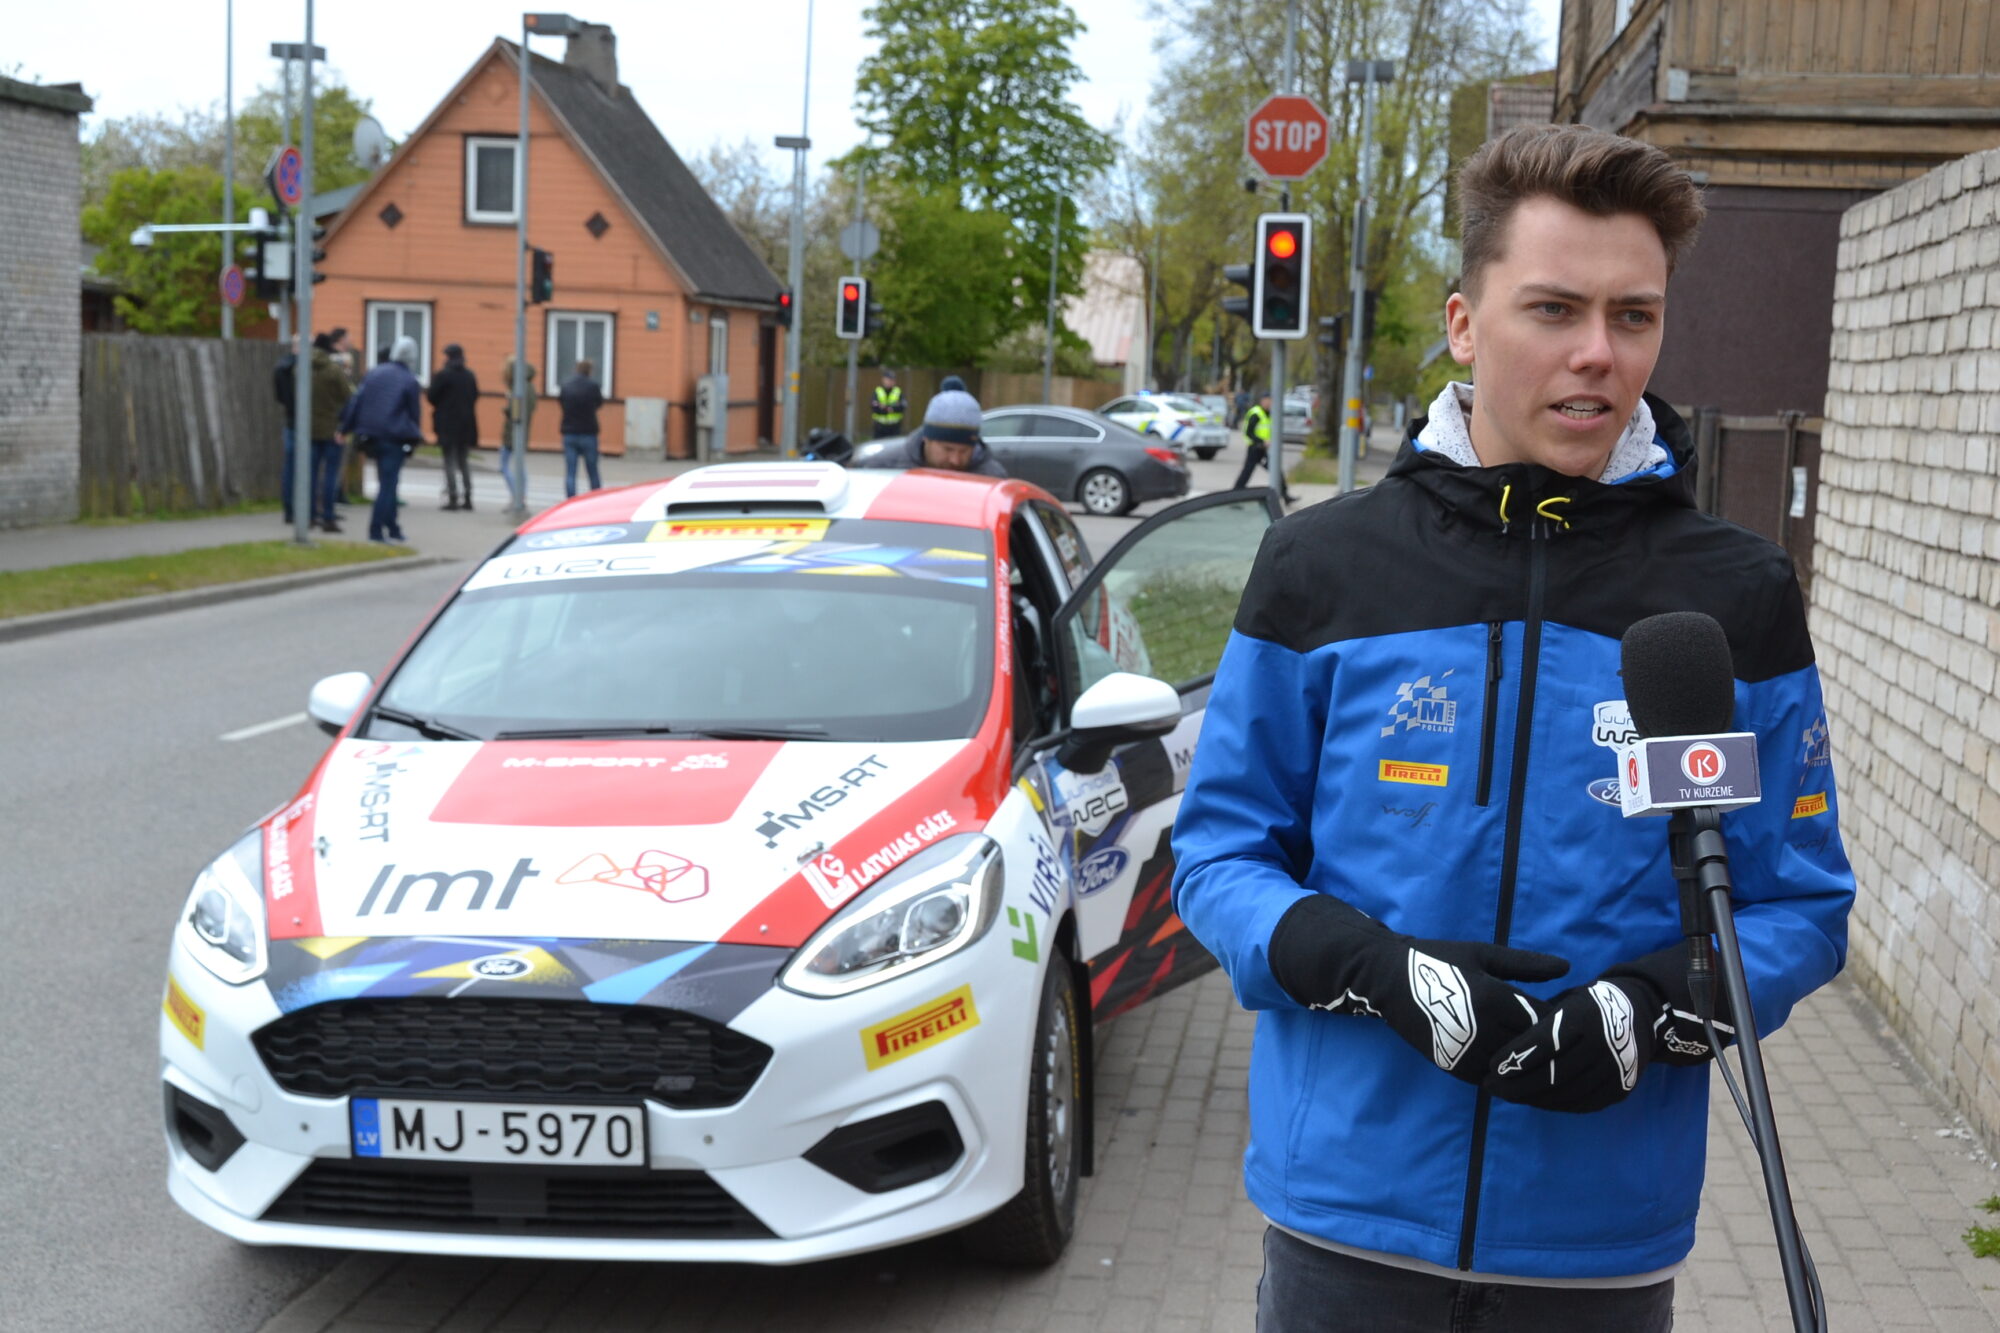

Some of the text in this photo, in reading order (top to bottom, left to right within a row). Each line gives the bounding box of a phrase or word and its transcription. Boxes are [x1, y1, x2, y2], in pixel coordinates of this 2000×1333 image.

[1255, 120, 1322, 152] STOP
[667, 523, 809, 537] PIRELLI
[503, 556, 657, 579] WRC
[1421, 700, 1444, 723] M
[1421, 724, 1454, 734] POLAND
[502, 757, 667, 769] M-SPORT
[1384, 763, 1441, 782] PIRELLI
[1679, 786, 1734, 800] TV KURZEME
[915, 809, 957, 842] GĀZE
[1079, 854, 1119, 894] Ford
[875, 997, 967, 1058] PIRELLI
[357, 1131, 378, 1146] LV
[393, 1107, 633, 1159] MJ-5970
